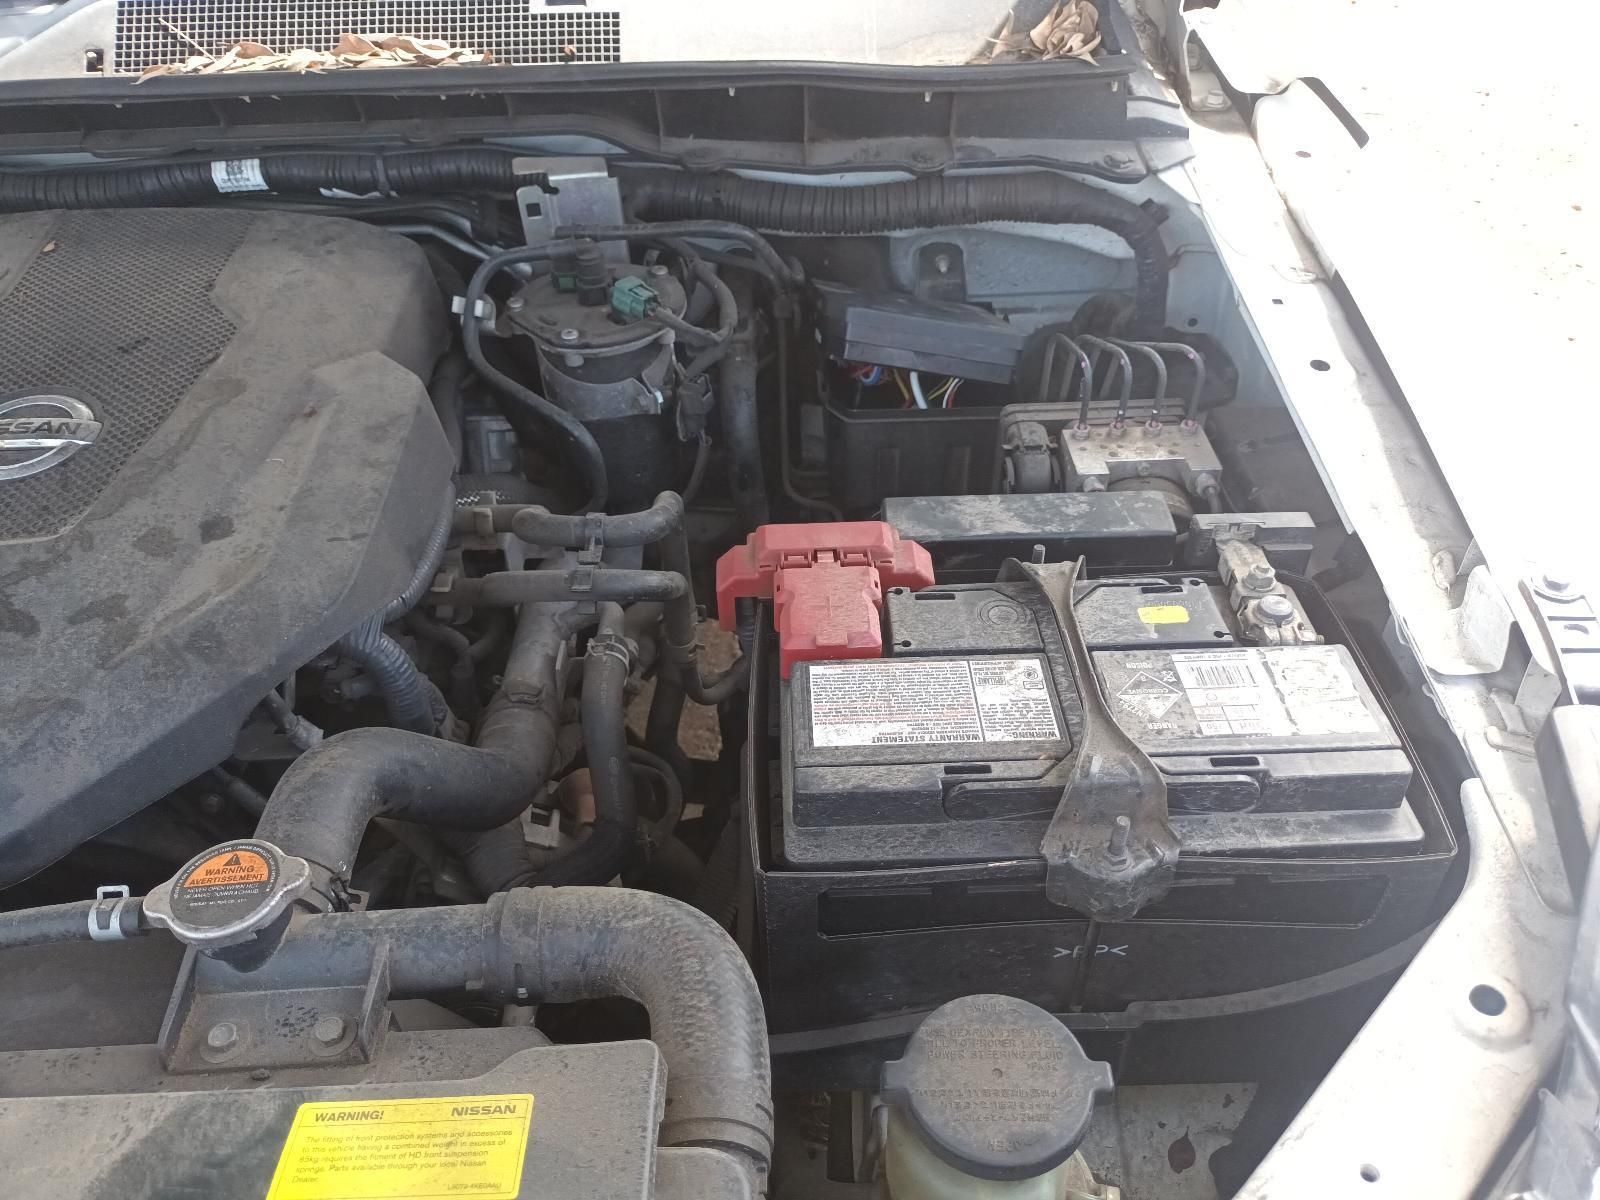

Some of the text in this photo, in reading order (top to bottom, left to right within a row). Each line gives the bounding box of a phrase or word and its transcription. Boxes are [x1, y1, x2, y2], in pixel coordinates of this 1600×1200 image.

[872, 734, 980, 743] WARRANTY STATEMENT
[205, 866, 254, 876] WARNING
[190, 874, 264, 885] AVERTISSEMENT
[927, 1050, 1064, 1060] POWER STEERING FLUID
[451, 1105, 517, 1116] NISSAN
[315, 1110, 385, 1122] WARNING!
[374, 1133, 416, 1142] protection
[417, 1132, 448, 1140] systems
[357, 1144, 383, 1152] having
[433, 1140, 458, 1149] weight
[321, 1154, 353, 1163] requires
[408, 1151, 422, 1159] HD
[444, 1150, 489, 1159] suspension
[352, 1163, 385, 1171] available
[387, 1162, 418, 1171] through
